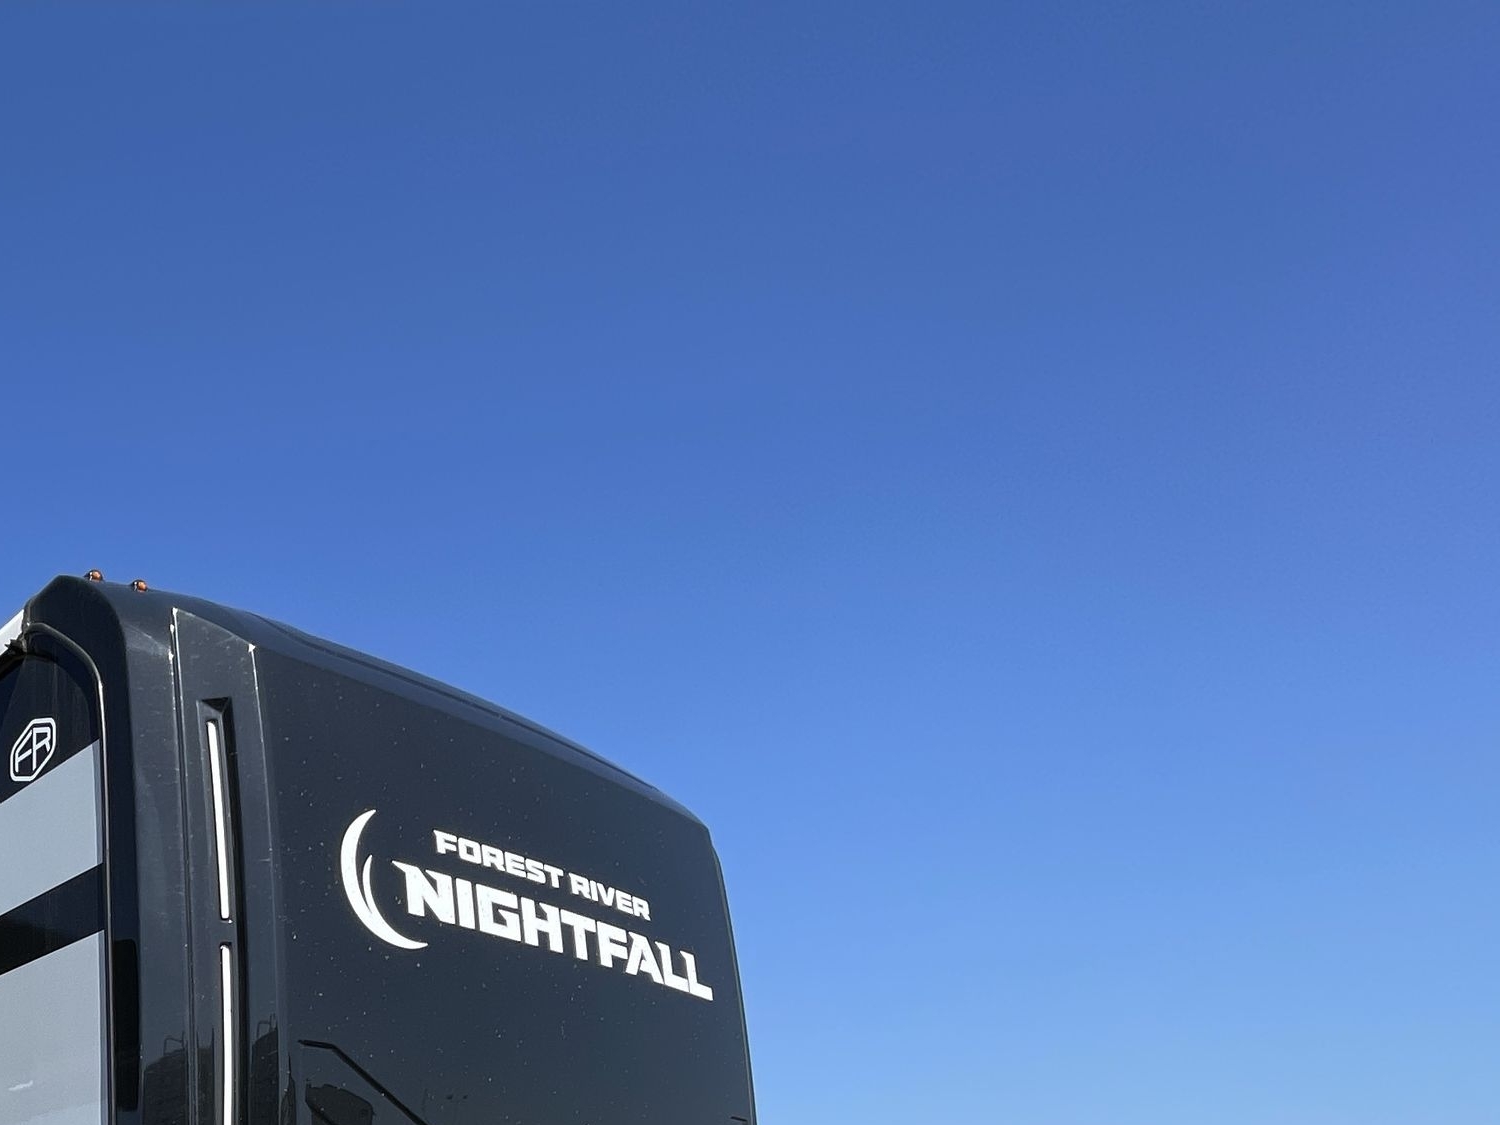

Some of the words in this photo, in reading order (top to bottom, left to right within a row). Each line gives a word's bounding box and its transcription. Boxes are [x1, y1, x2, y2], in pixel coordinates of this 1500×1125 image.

[391, 859, 714, 1001] NIGHTFALL
[432, 828, 564, 889] FOREST
[568, 871, 651, 922] RIVER
